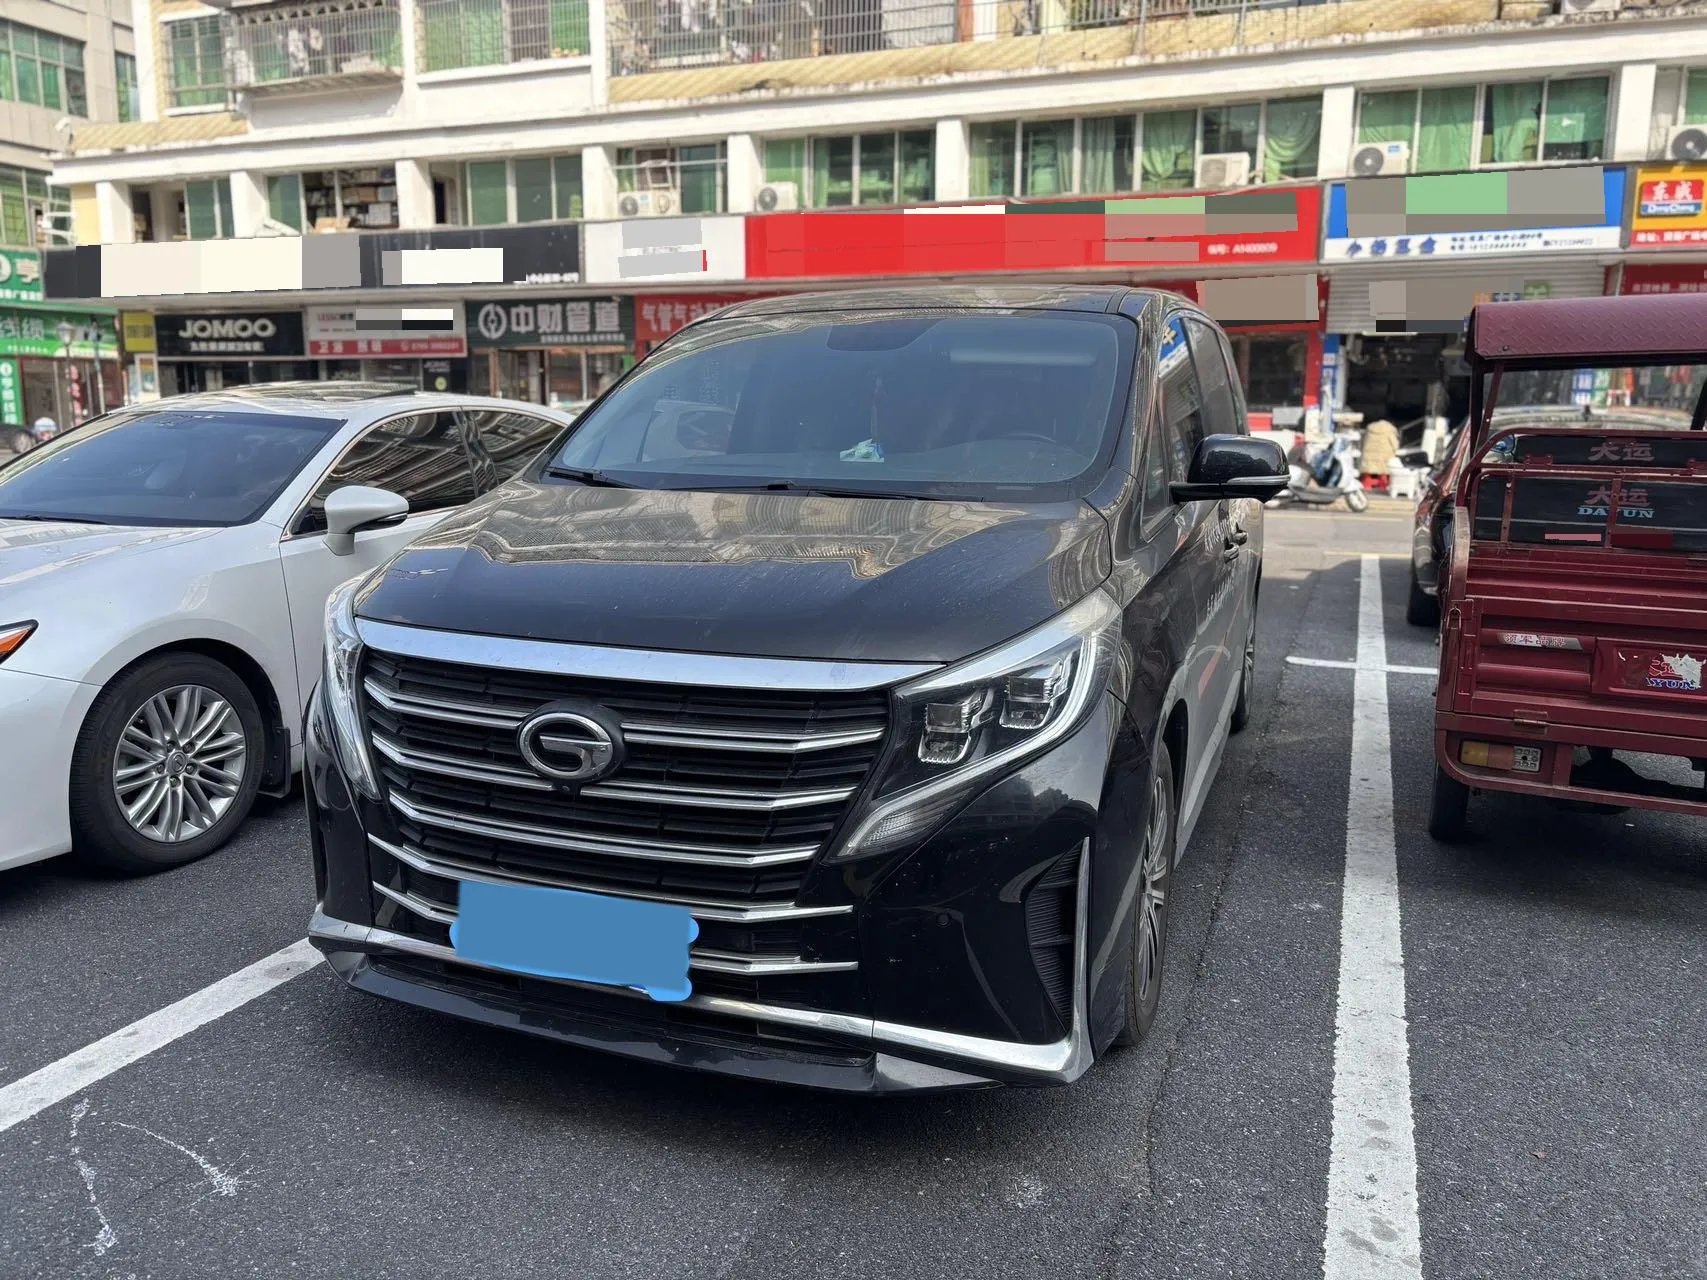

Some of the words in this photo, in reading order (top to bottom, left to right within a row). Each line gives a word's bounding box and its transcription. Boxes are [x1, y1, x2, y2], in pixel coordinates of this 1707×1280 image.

[510, 301, 620, 334] 中财管道
[178, 318, 276, 339] JOMOO
[1587, 442, 1656, 462] 大运
[1584, 485, 1651, 507] 大运
[1577, 507, 1656, 519] DAUN
